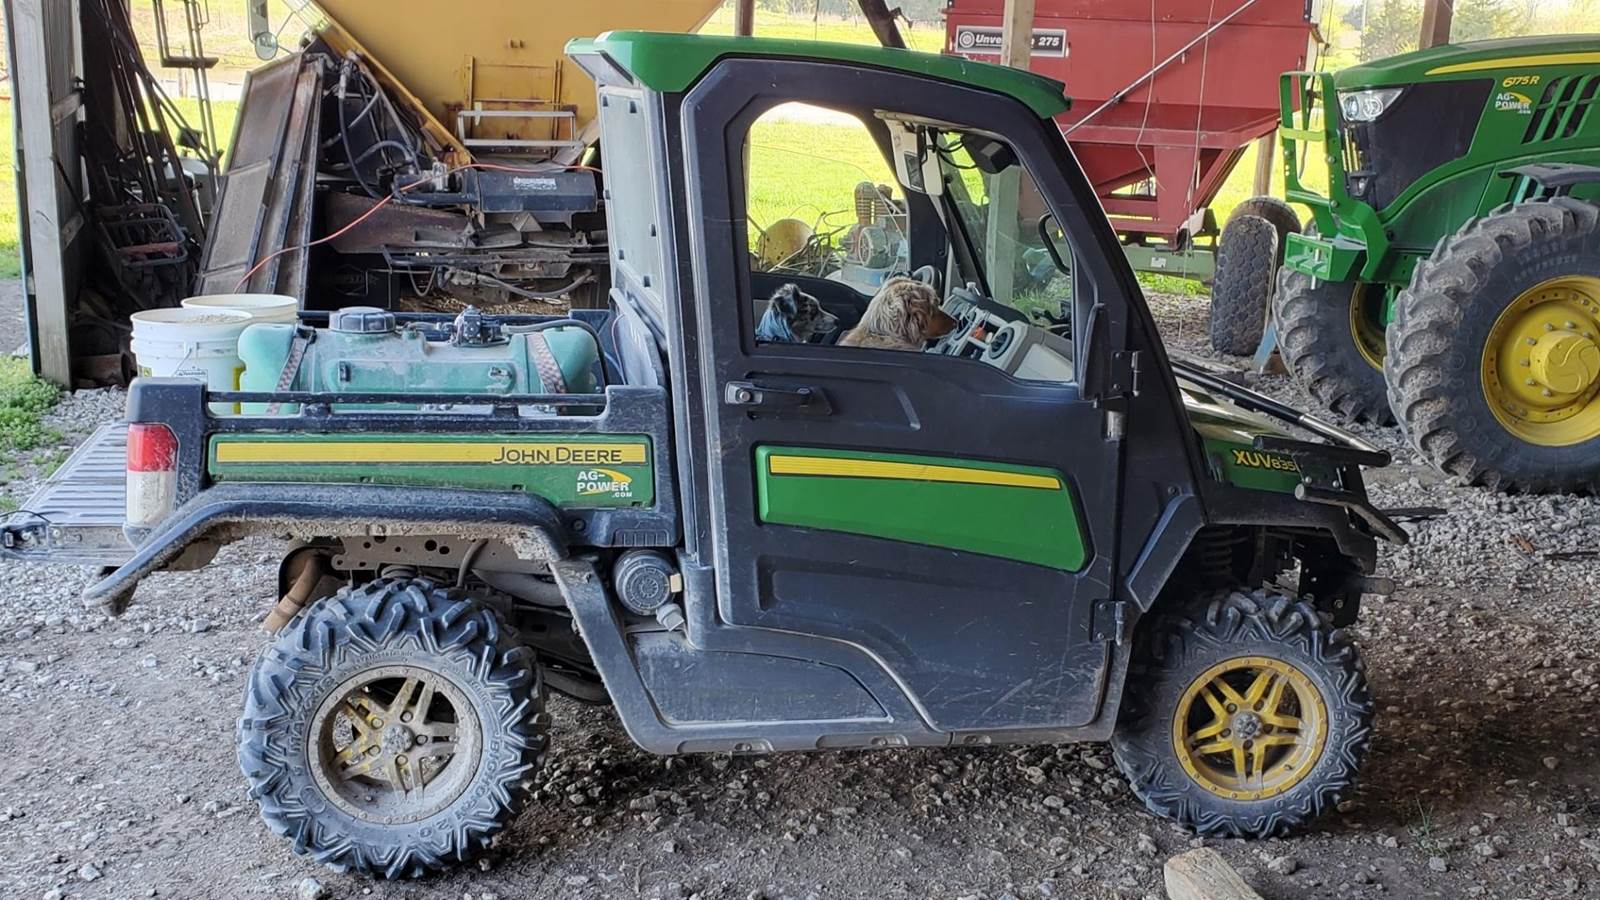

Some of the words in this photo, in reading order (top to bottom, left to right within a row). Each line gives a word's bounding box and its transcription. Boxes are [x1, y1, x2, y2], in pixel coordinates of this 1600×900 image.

[1038, 36, 1060, 47] 275
[1496, 92, 1515, 101] AG-
[1495, 101, 1530, 109] POWER
[494, 446, 550, 463] JOHN
[555, 446, 622, 463] DEERE
[577, 470, 605, 481] AG-
[576, 481, 630, 493] POWER
[454, 740, 500, 820] BIGHORN
